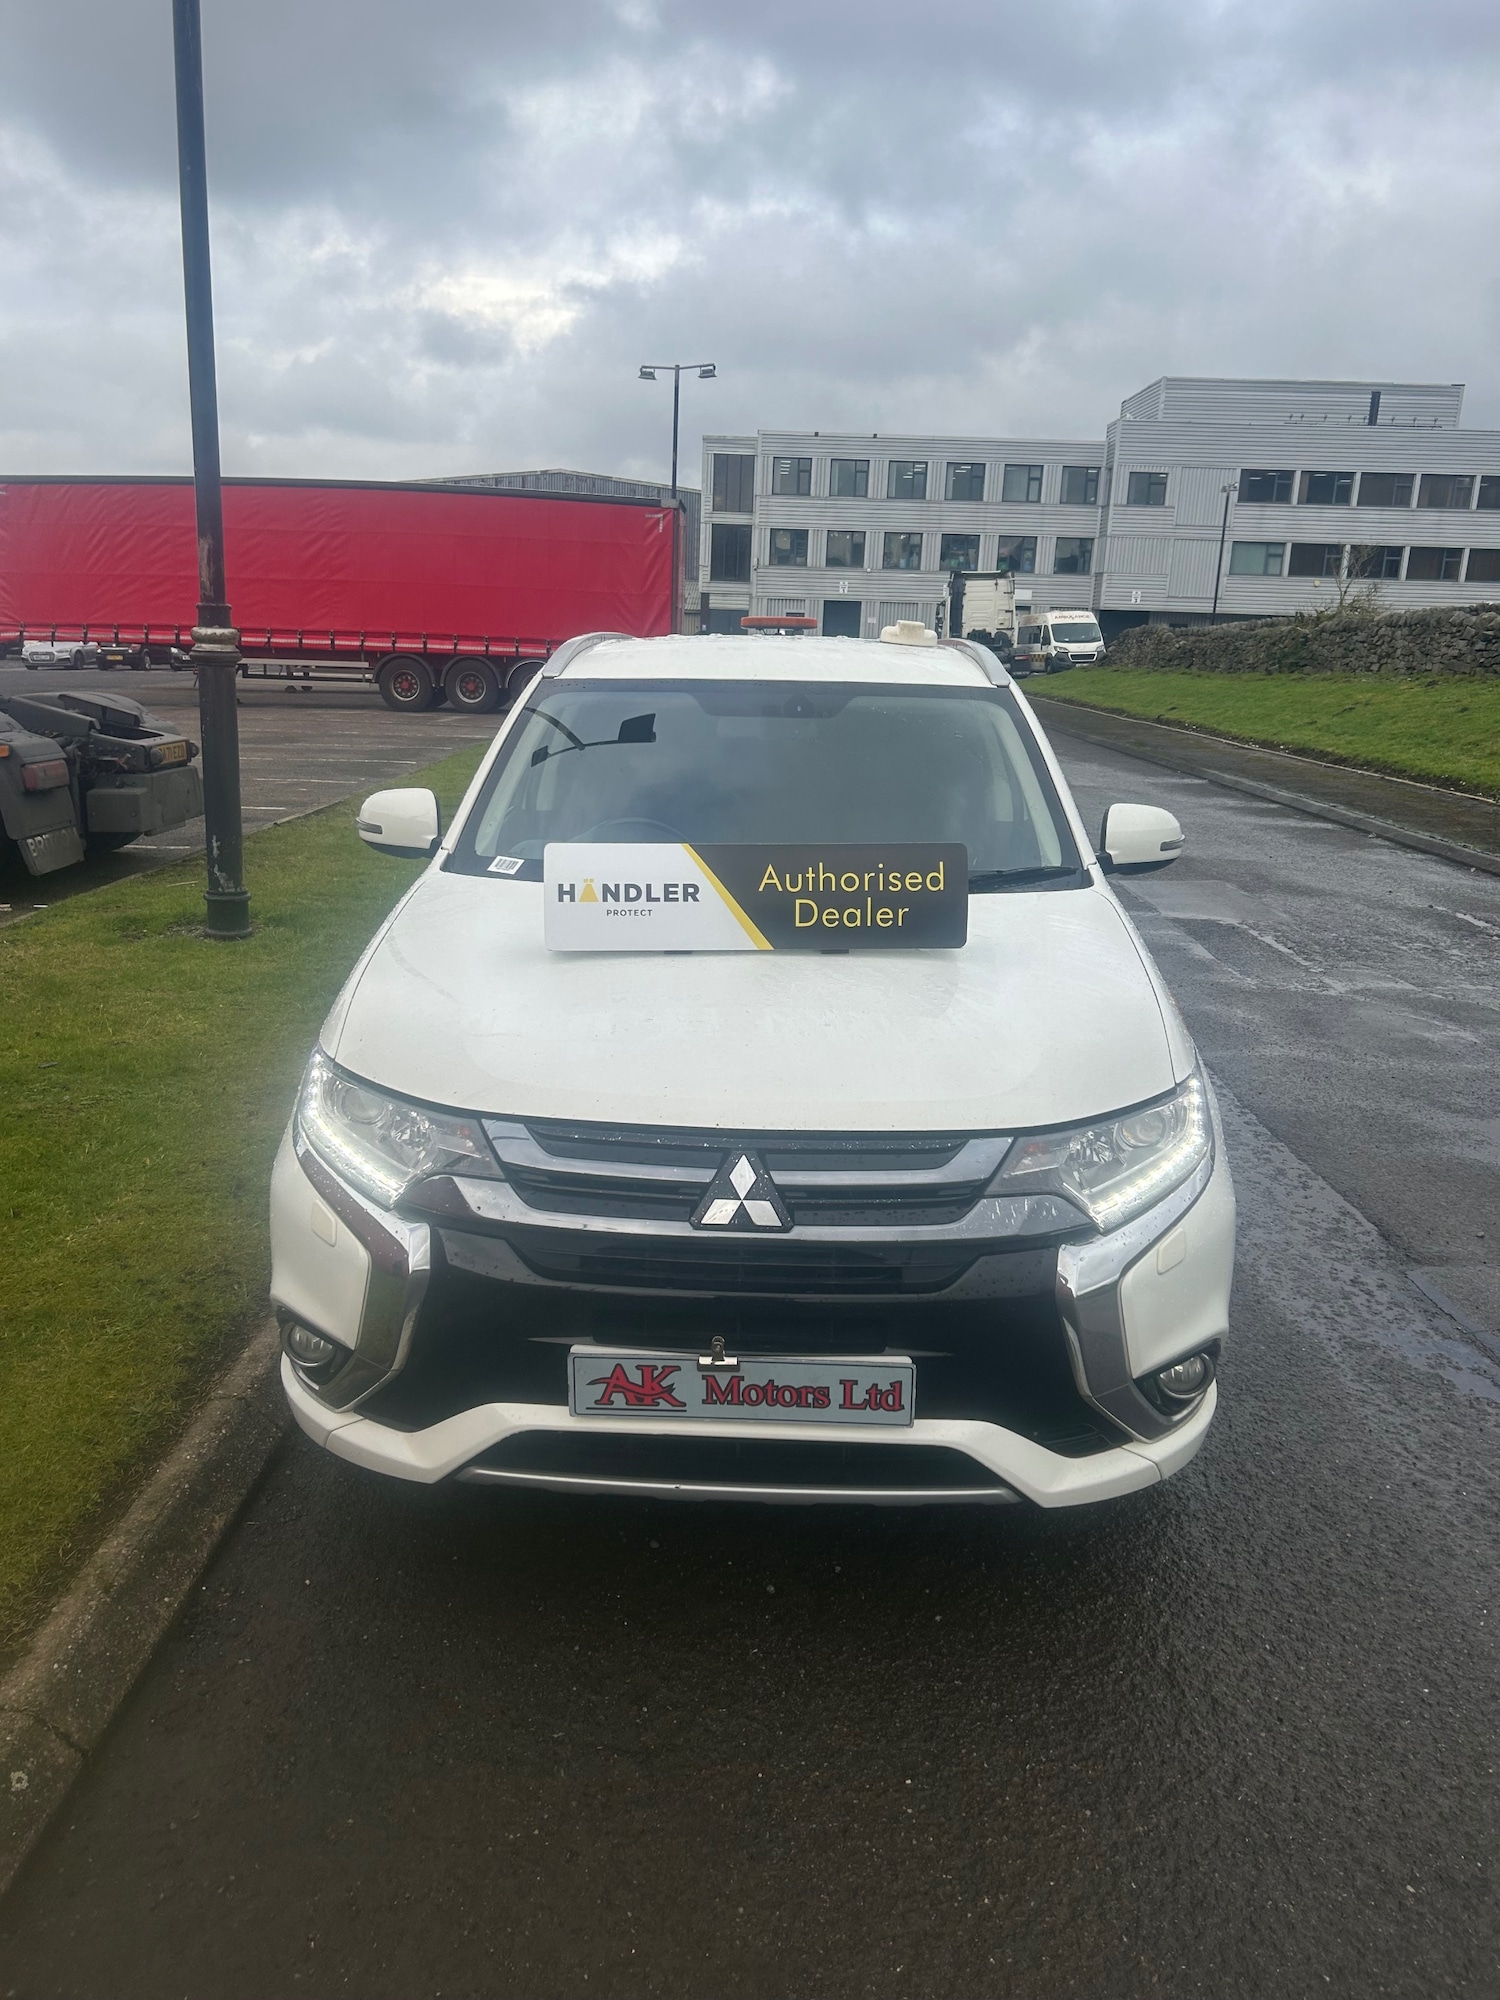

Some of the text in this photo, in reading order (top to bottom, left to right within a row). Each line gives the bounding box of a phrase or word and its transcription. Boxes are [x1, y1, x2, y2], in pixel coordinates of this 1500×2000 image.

[758, 861, 945, 892] Authorised
[606, 909, 653, 917] PROTECT
[795, 897, 910, 928] Dealer
[586, 1363, 905, 1412] AK Motors Ltd
